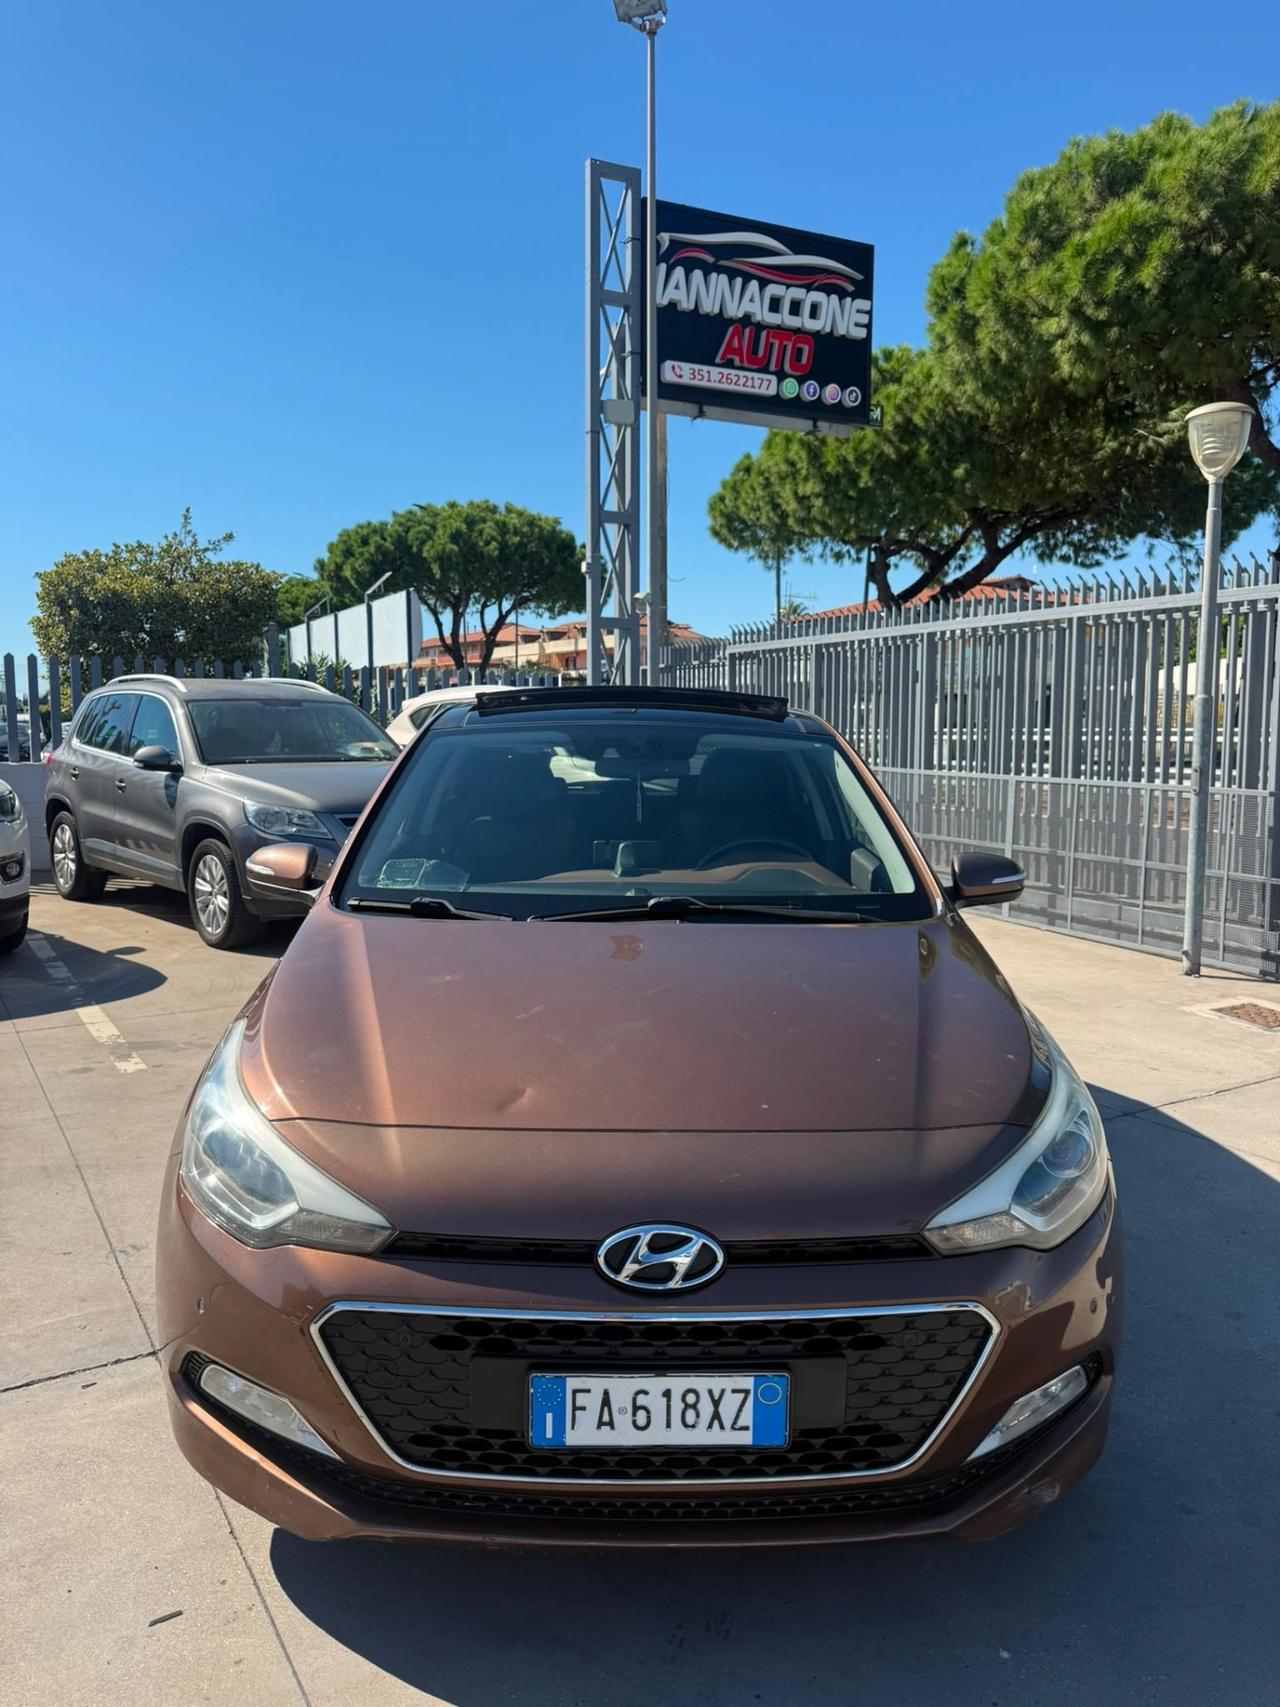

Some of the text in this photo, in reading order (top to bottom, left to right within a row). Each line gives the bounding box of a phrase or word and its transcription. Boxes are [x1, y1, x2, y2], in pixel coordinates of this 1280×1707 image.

[656, 262, 871, 339] IANNACCONE
[716, 323, 815, 376] AUTO
[688, 368, 772, 391] 351.2622177
